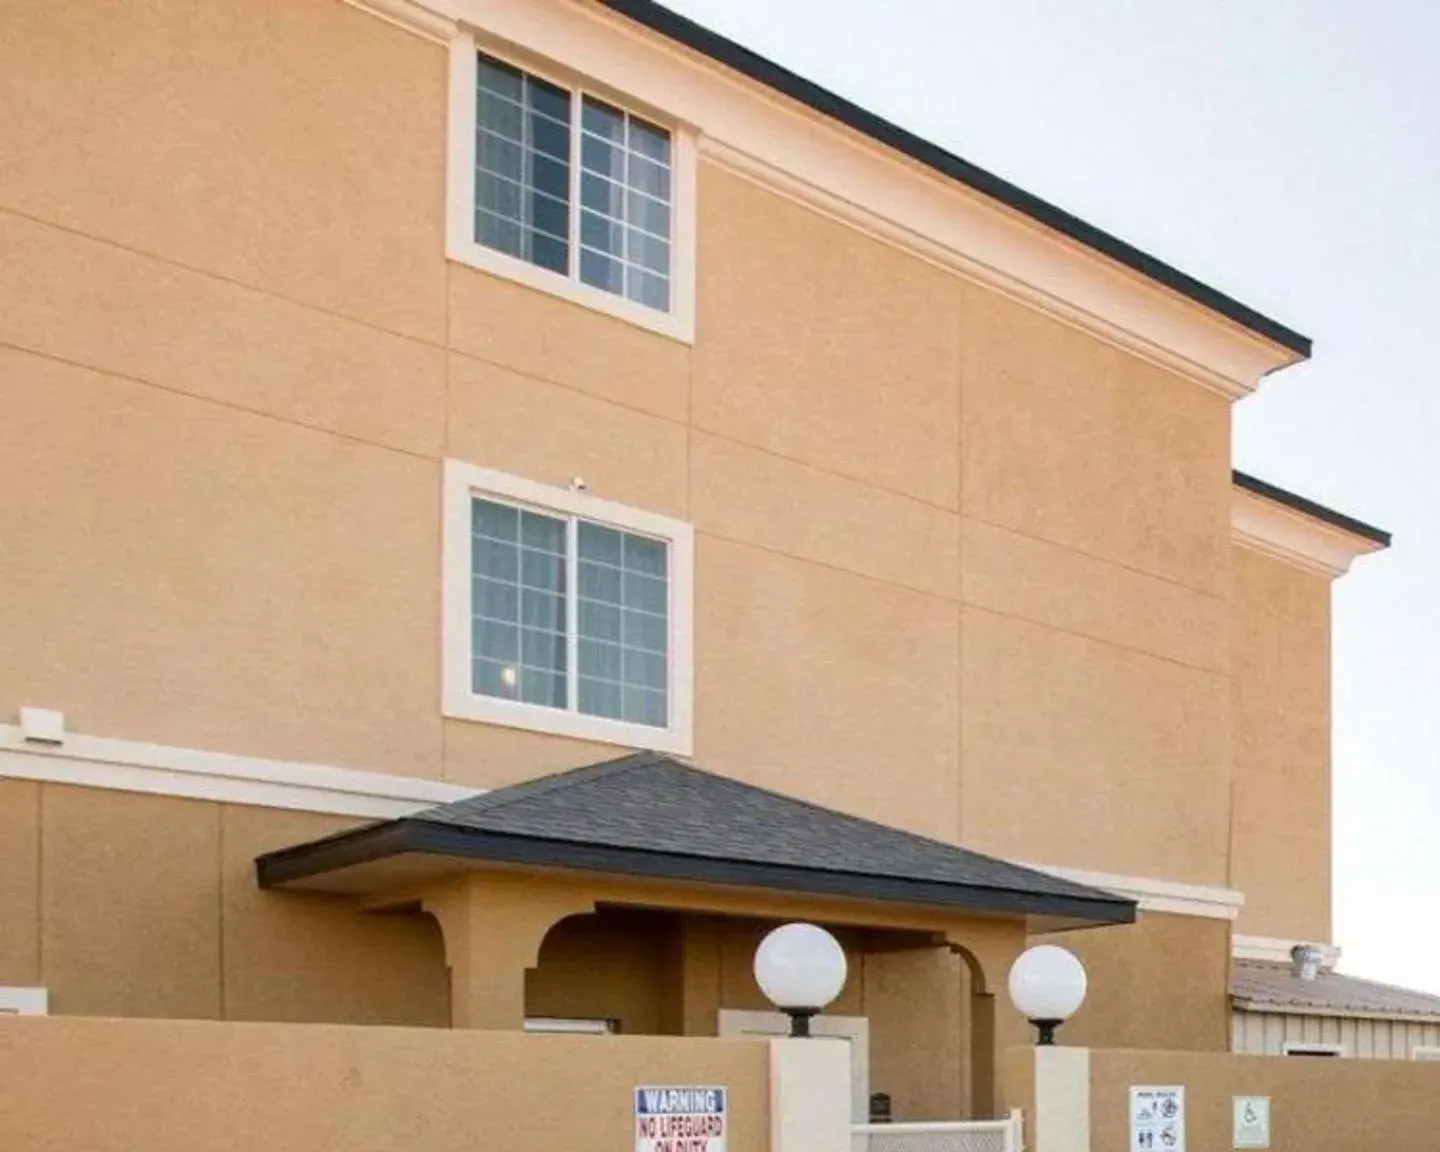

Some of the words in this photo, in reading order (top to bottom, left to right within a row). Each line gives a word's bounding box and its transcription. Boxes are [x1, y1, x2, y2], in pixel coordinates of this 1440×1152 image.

[645, 1090, 717, 1113] WARNING
[639, 1117, 656, 1137] NO
[660, 1116, 722, 1137] LIFEGUARD
